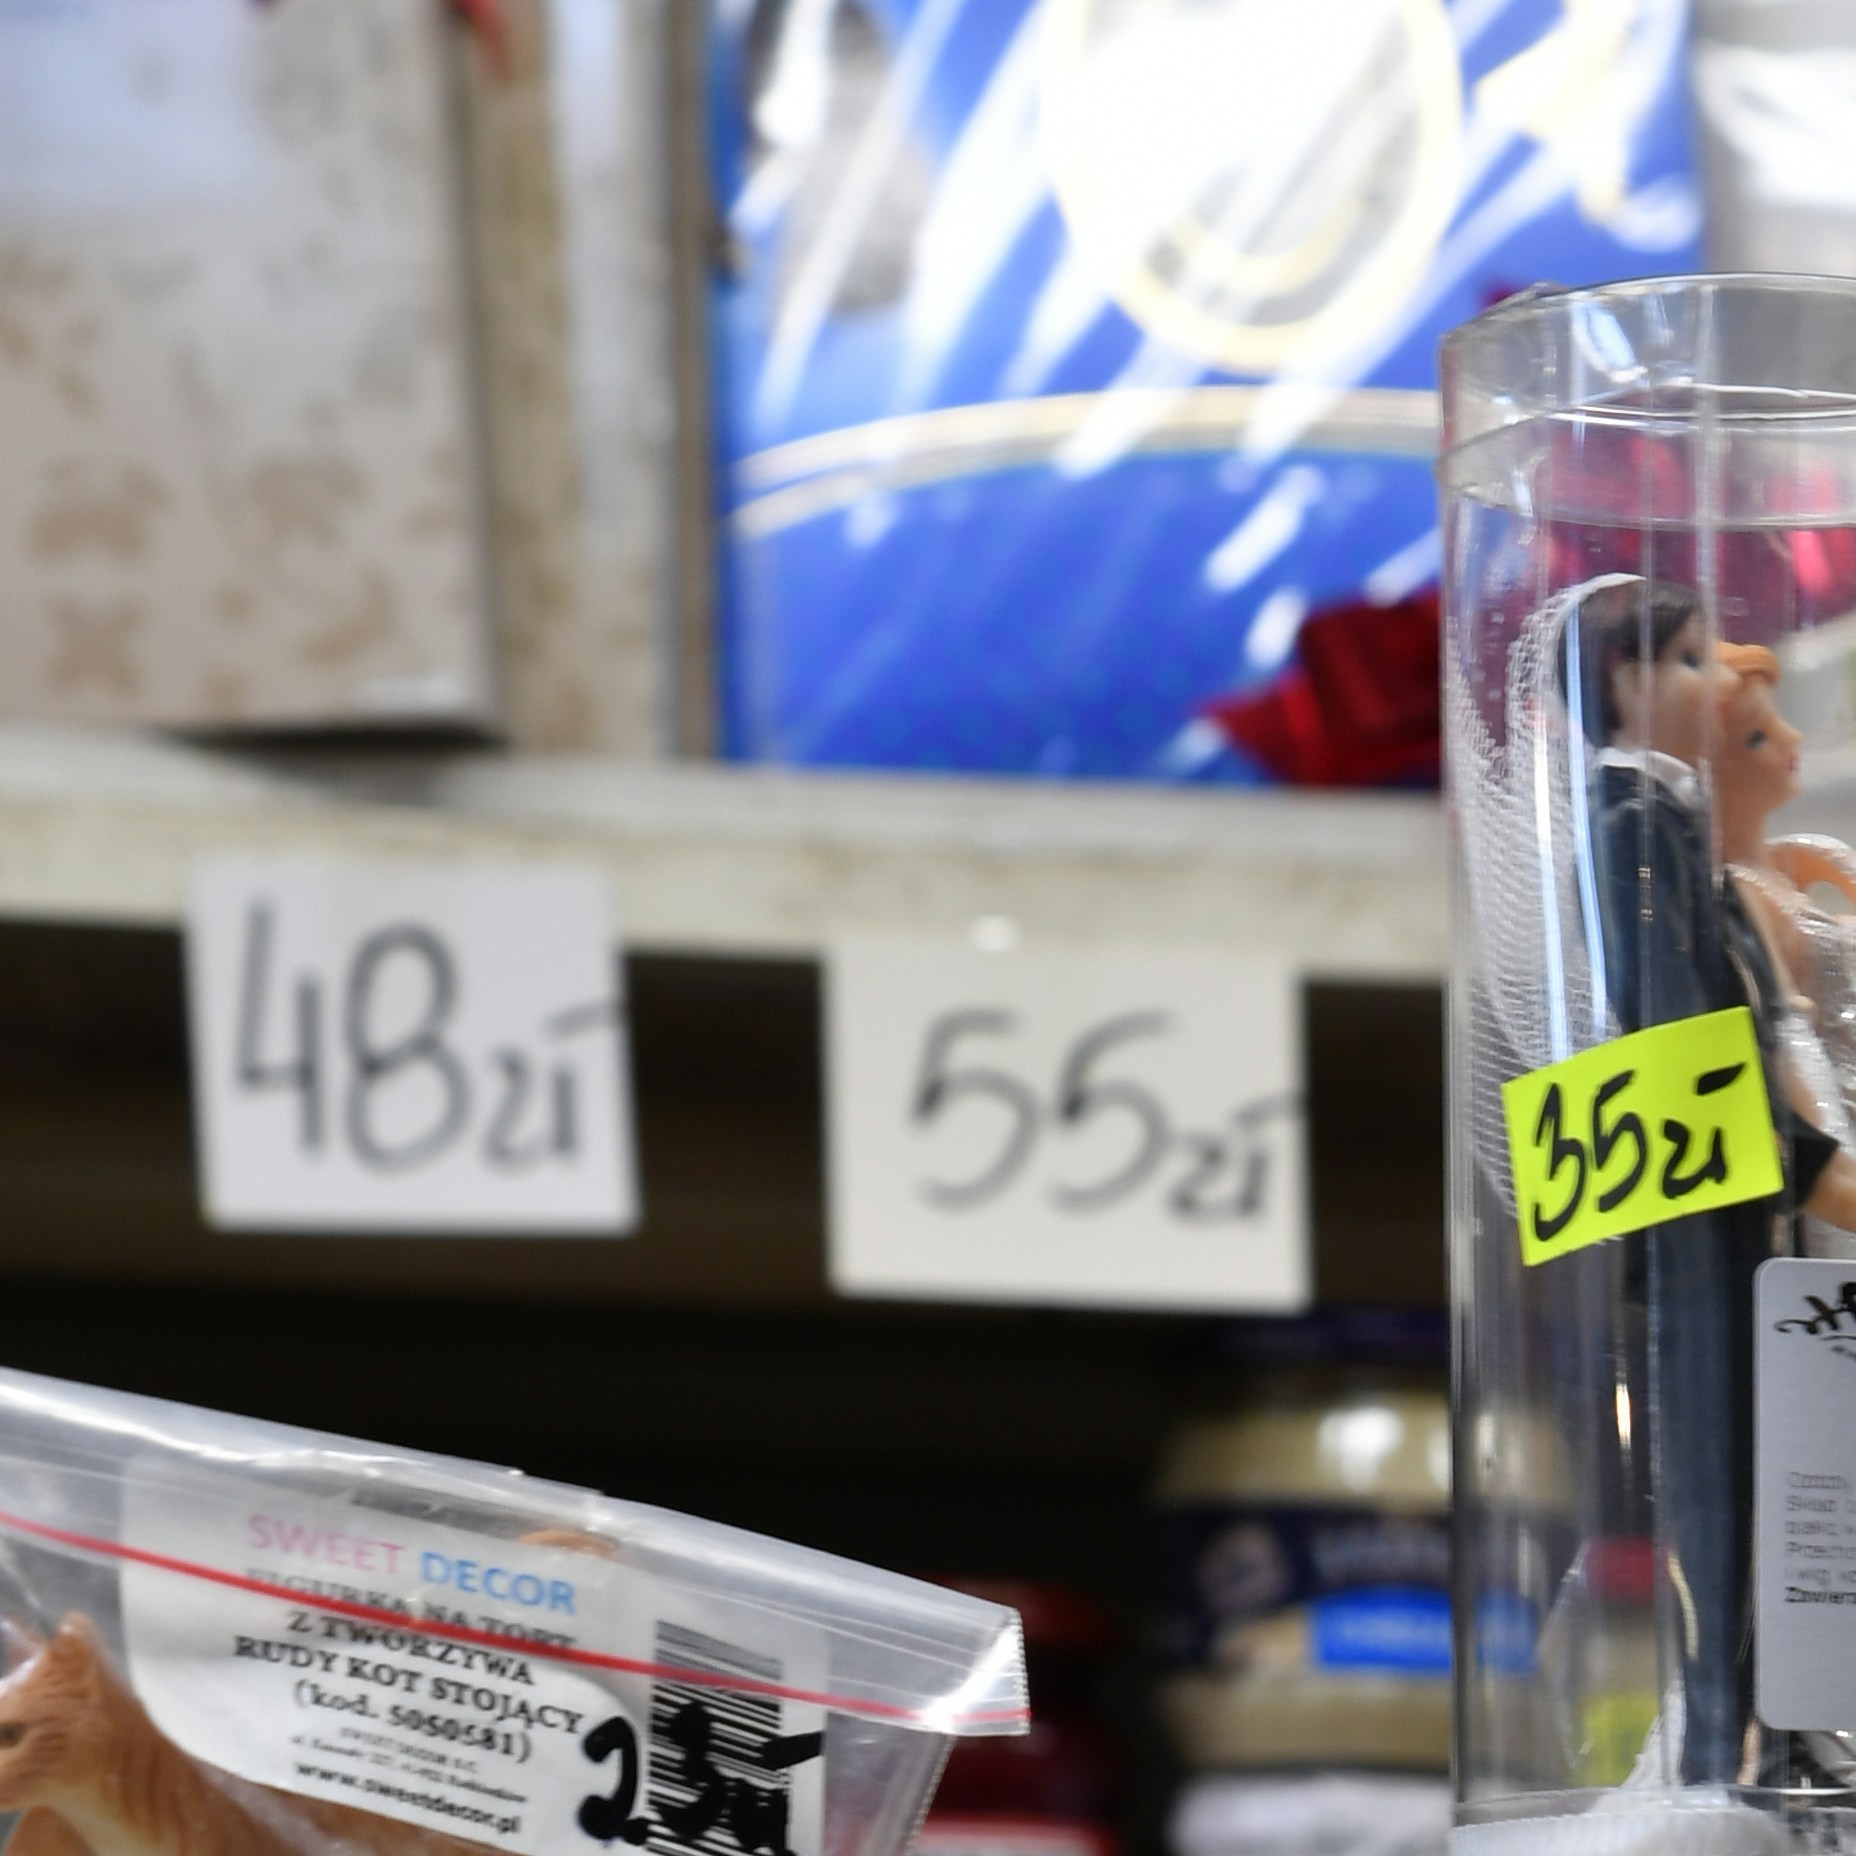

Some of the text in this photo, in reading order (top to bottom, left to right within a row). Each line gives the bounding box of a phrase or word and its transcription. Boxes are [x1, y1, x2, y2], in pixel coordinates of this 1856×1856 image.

[247, 1513, 577, 1615] SWEET DECOR
[233, 1635, 584, 1734] RUDY KOT STOJĄCY
[285, 1609, 535, 1686] Z TWORZYWA
[293, 1678, 380, 1721] (kod.
